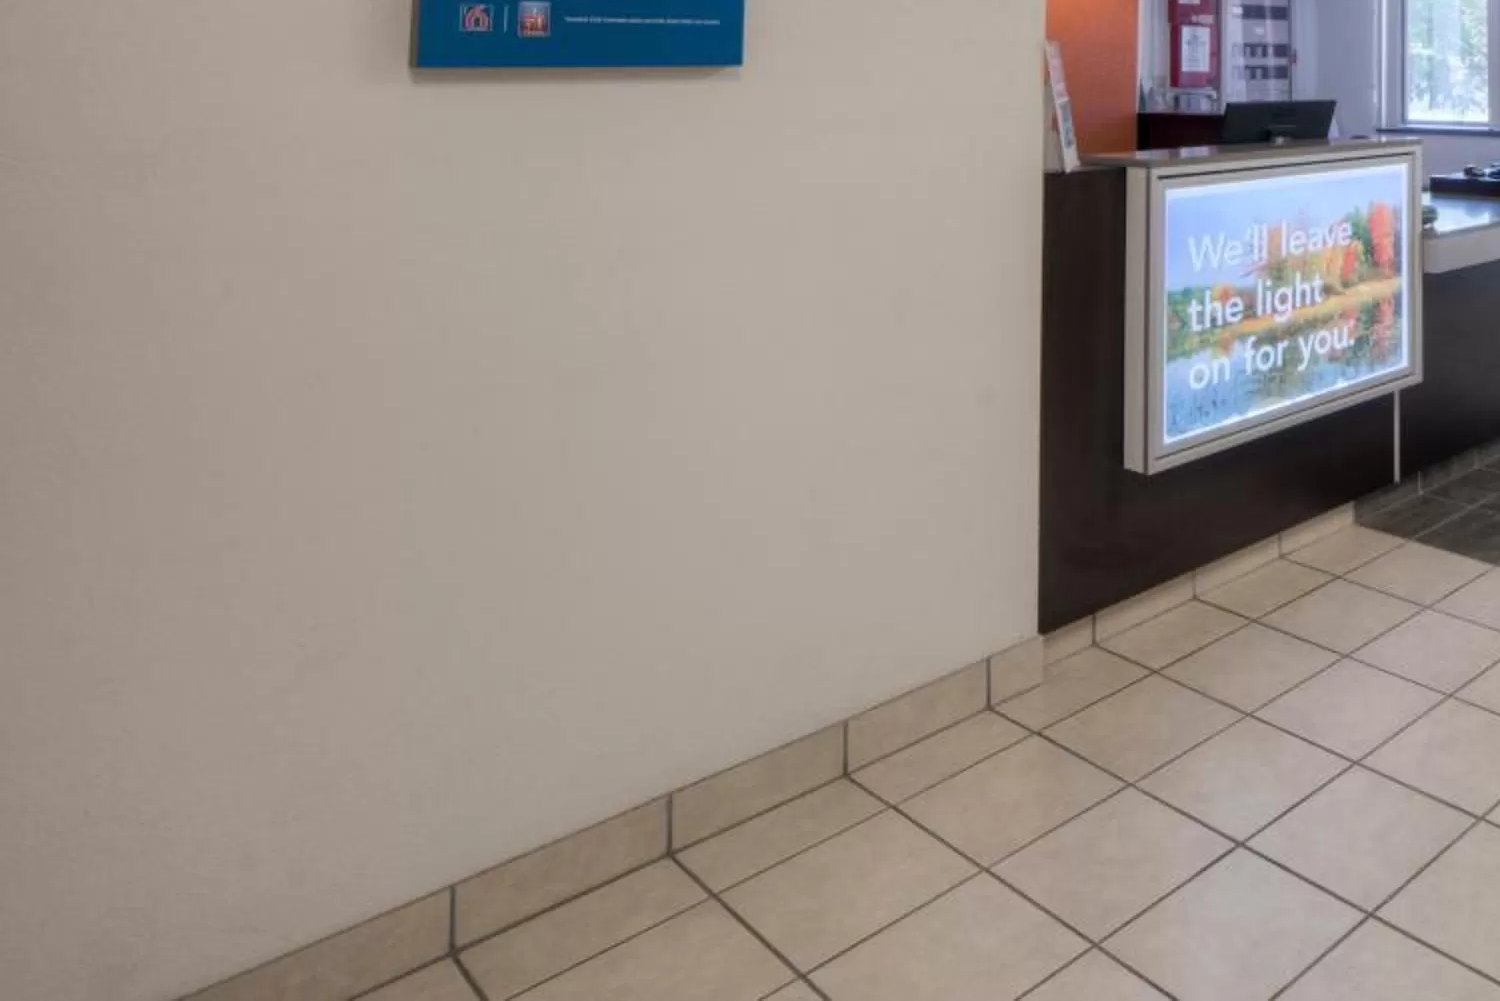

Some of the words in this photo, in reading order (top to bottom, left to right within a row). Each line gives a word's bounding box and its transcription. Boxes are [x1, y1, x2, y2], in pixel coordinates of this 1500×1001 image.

[1188, 223, 1268, 272] We'll
[1280, 218, 1353, 256] leave
[1188, 288, 1244, 332] the
[1256, 270, 1325, 323] light
[1189, 355, 1231, 390] on
[1244, 335, 1290, 375] for
[1298, 323, 1356, 372] you.
